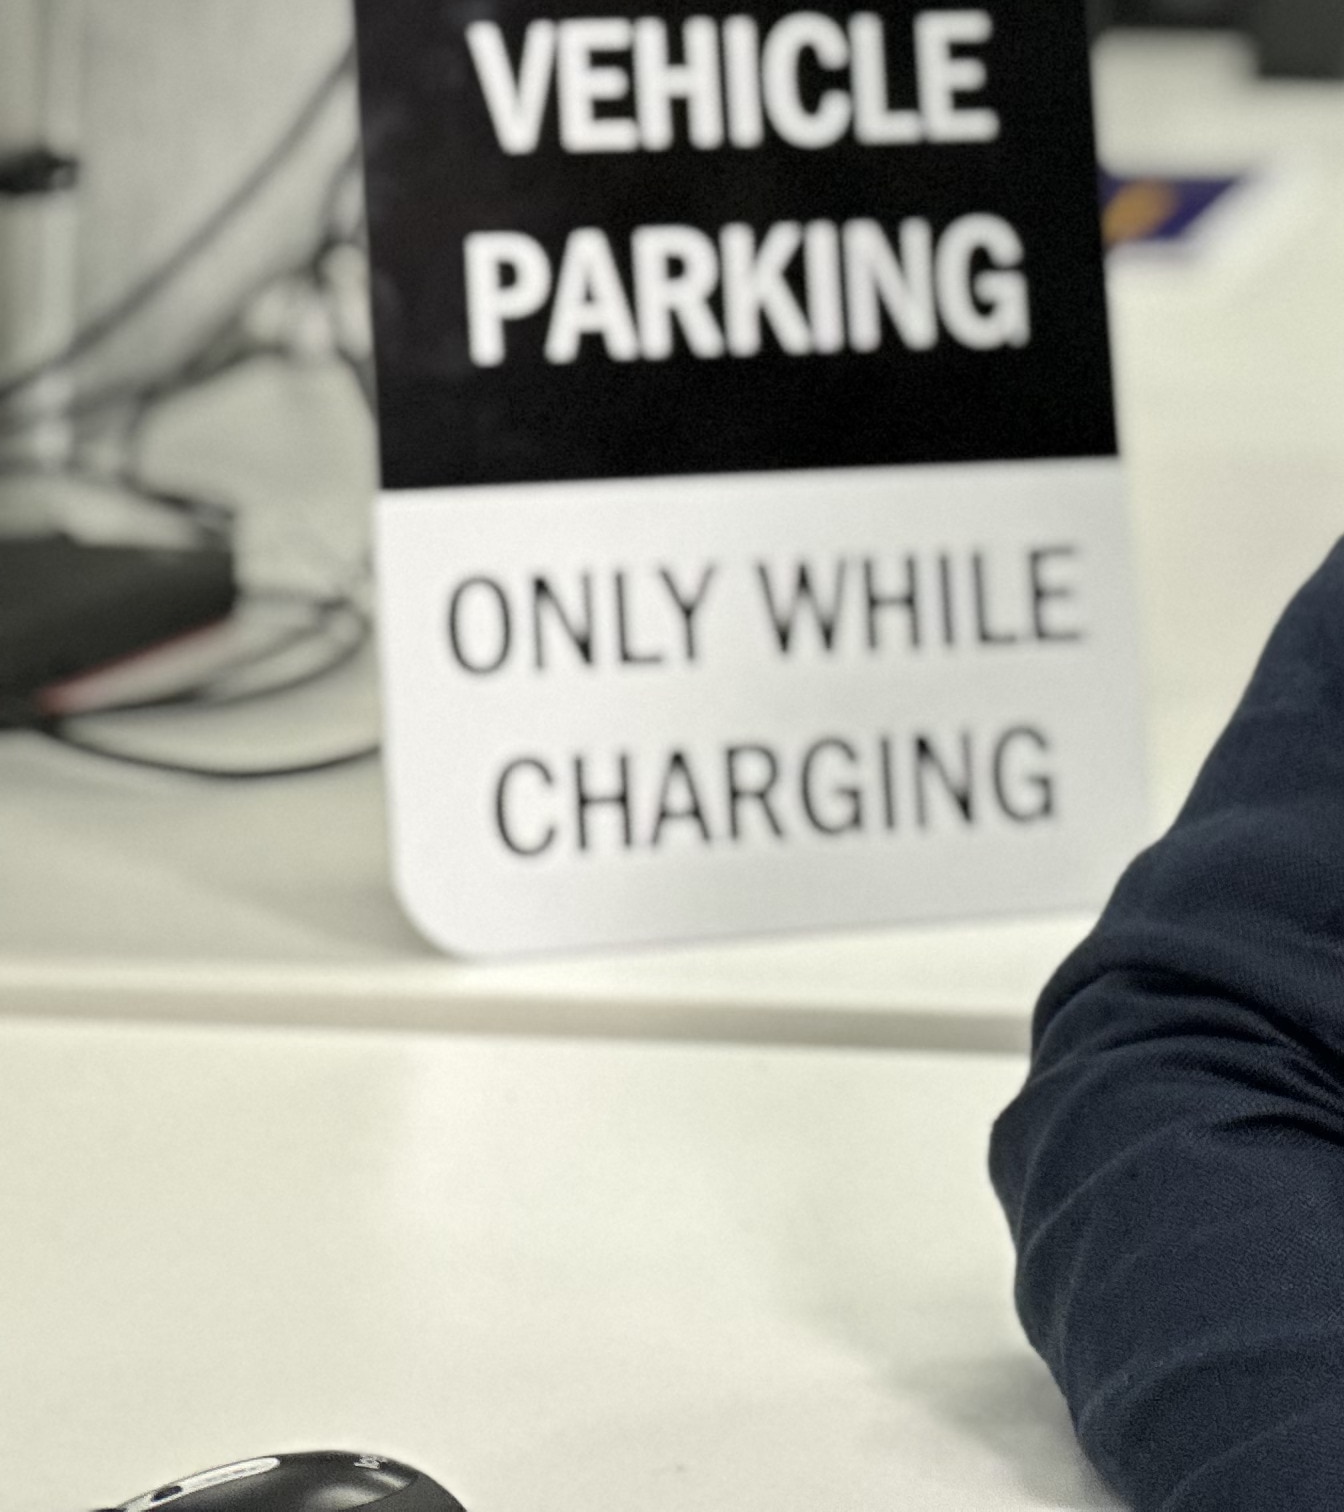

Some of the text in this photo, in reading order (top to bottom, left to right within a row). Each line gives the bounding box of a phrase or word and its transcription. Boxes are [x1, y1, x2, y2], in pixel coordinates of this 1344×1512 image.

[465, 10, 999, 155] VEHICLE
[462, 213, 1030, 367] PARKING
[447, 545, 1082, 675] ONLY WHILE
[494, 724, 1056, 856] CHARGING
